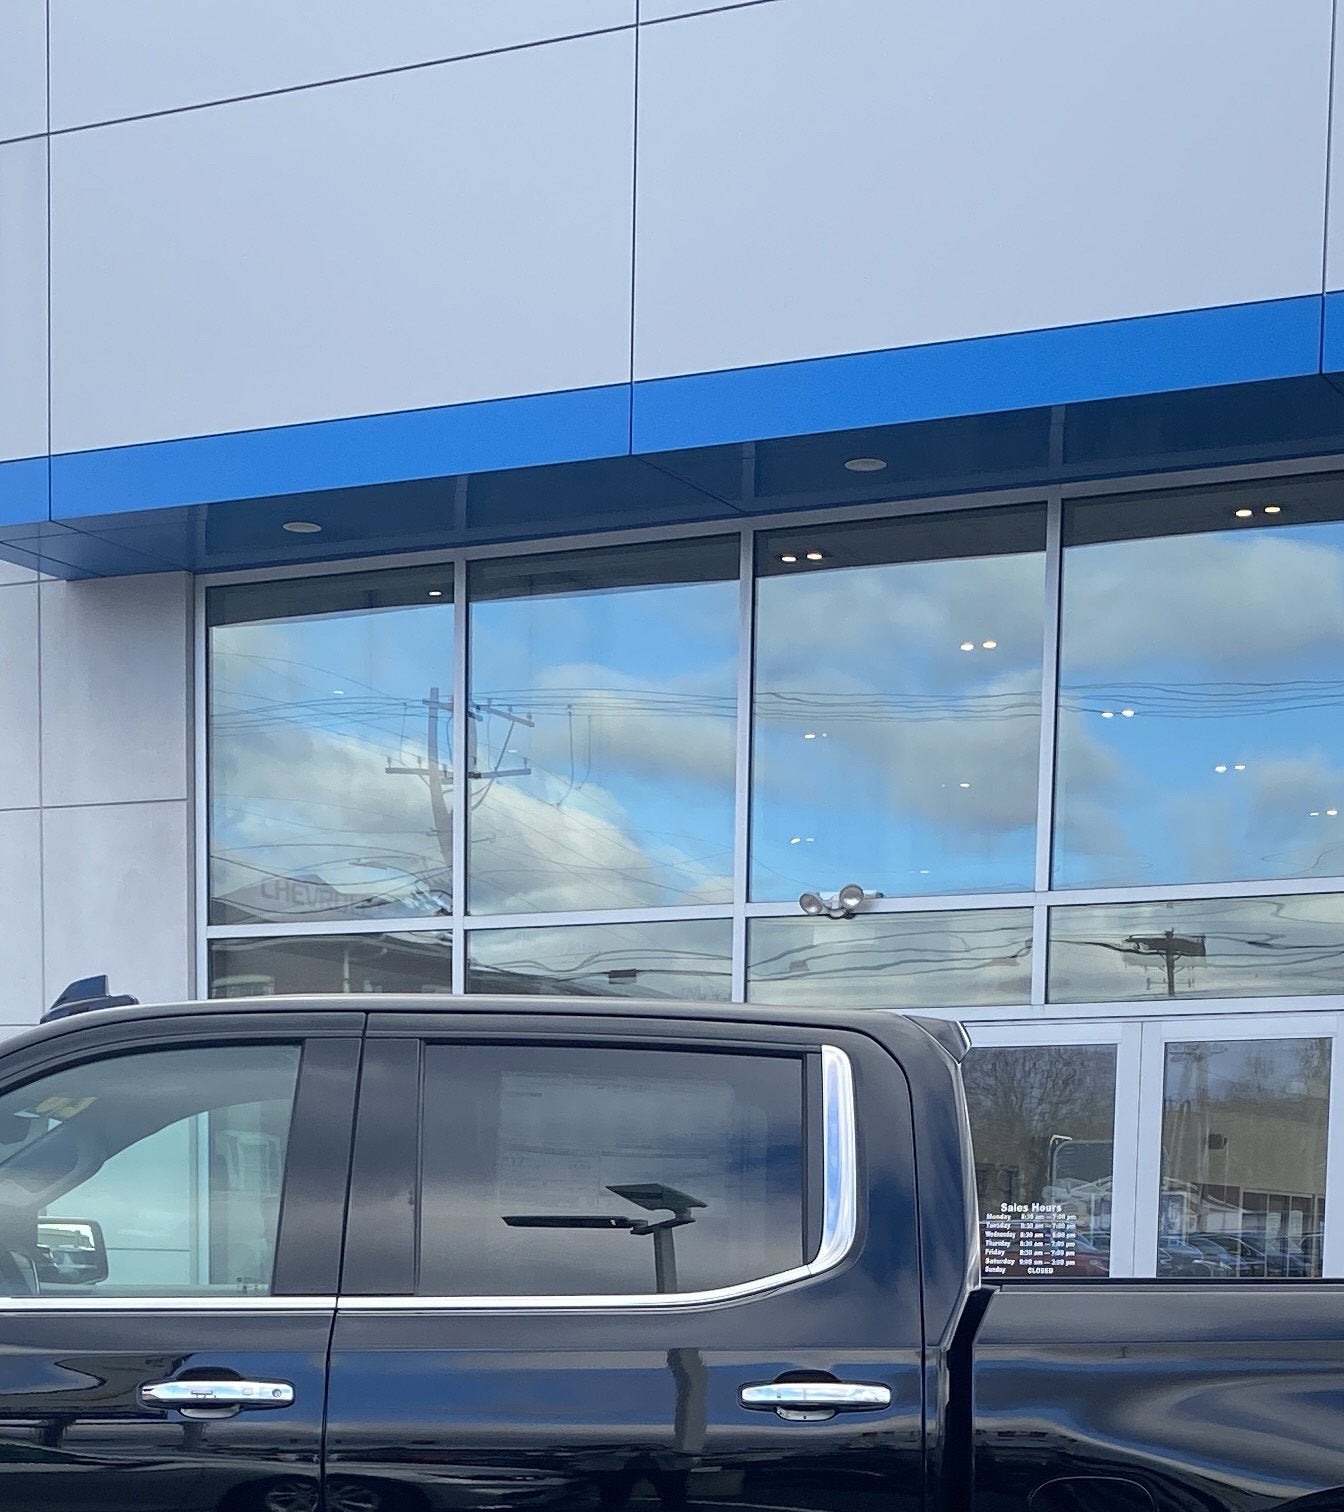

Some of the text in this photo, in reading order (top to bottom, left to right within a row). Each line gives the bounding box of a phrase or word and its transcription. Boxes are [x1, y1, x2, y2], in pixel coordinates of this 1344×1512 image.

[1000, 1203, 1062, 1213] Sales Hours
[986, 1213, 1011, 1221] Monday
[986, 1222, 1011, 1230] Tuesday
[984, 1231, 1016, 1239] Wednesday
[985, 1240, 1011, 1248] Thursday
[984, 1248, 1006, 1256] Friday
[984, 1257, 1016, 1266] Saturday
[984, 1266, 1007, 1274] Sunday
